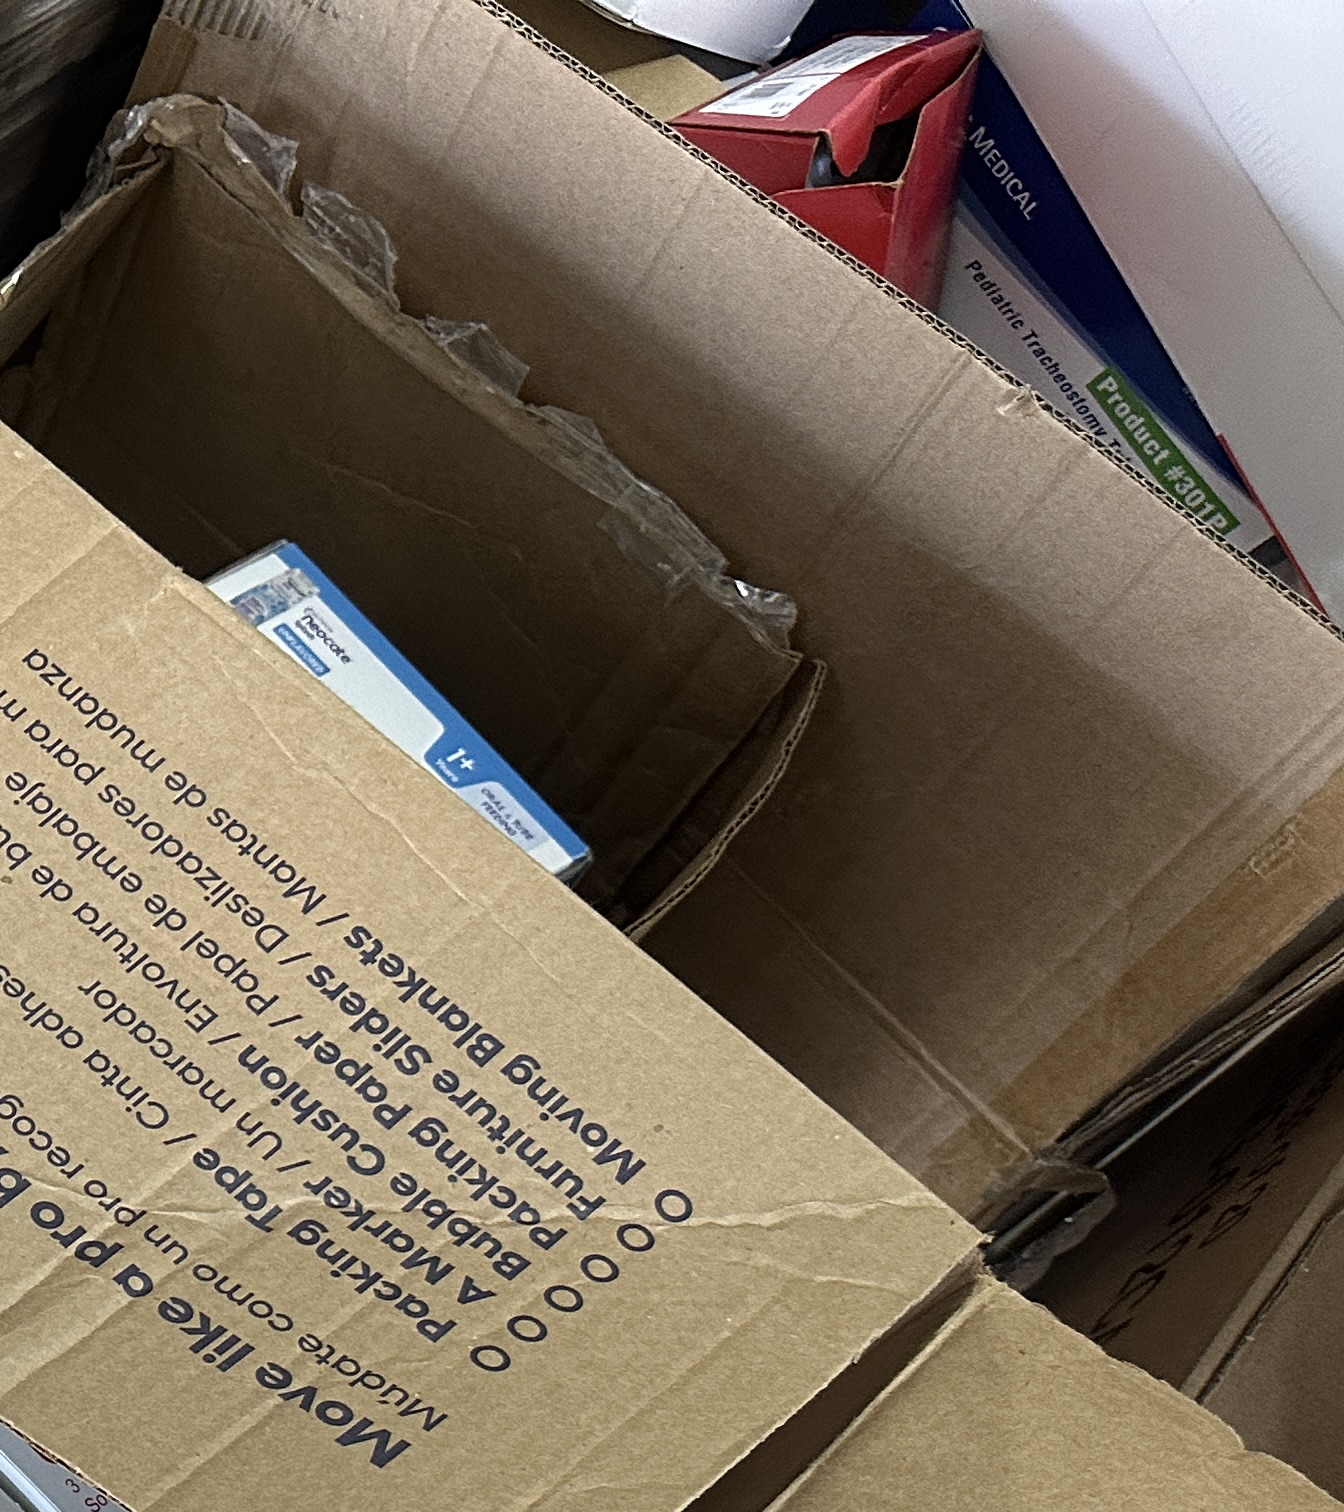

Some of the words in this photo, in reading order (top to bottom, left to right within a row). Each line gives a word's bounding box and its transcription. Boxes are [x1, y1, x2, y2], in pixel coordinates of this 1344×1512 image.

[969, 127, 1036, 220] MEDICAL
[964, 260, 1024, 329] Pediatric
[1022, 329, 1107, 436] Tracheostomy
[1096, 378, 1169, 466] Product
[1164, 464, 1226, 533] #301P
[301, 615, 350, 664] neocate
[22, 649, 165, 773] mudanza
[24, 720, 105, 786] para
[5, 772, 142, 892] embalaje
[165, 771, 206, 807] de
[32, 866, 72, 901] de
[98, 785, 289, 953] Deslizadores
[207, 808, 326, 915] Mantas
[145, 894, 186, 931] de
[72, 902, 218, 1033] Envoltura
[180, 931, 279, 1016] Papel
[344, 926, 505, 1068] Blankets
[78, 981, 236, 1113] marcador
[306, 965, 432, 1075] Sliders
[83, 1049, 169, 1129] Cinta
[238, 1045, 385, 1176] Cushion
[294, 1031, 413, 1130] Paper
[500, 1054, 646, 1185] Moving
[236, 1112, 282, 1160] Un
[408, 1118, 568, 1250] Packing
[433, 1070, 606, 1220] Furniture
[31, 1200, 124, 1270] pro
[84, 1180, 147, 1227] pro
[193, 1148, 283, 1233] Tape
[303, 1177, 455, 1285] Marker
[390, 1173, 531, 1281] Bubble
[112, 1264, 153, 1297] a
[144, 1225, 188, 1265] un
[287, 1220, 457, 1343] Packing
[457, 1276, 497, 1304] A
[158, 1297, 255, 1372] like
[193, 1265, 293, 1331] como
[256, 1362, 411, 1468] Move
[299, 1334, 448, 1432] Múdate
